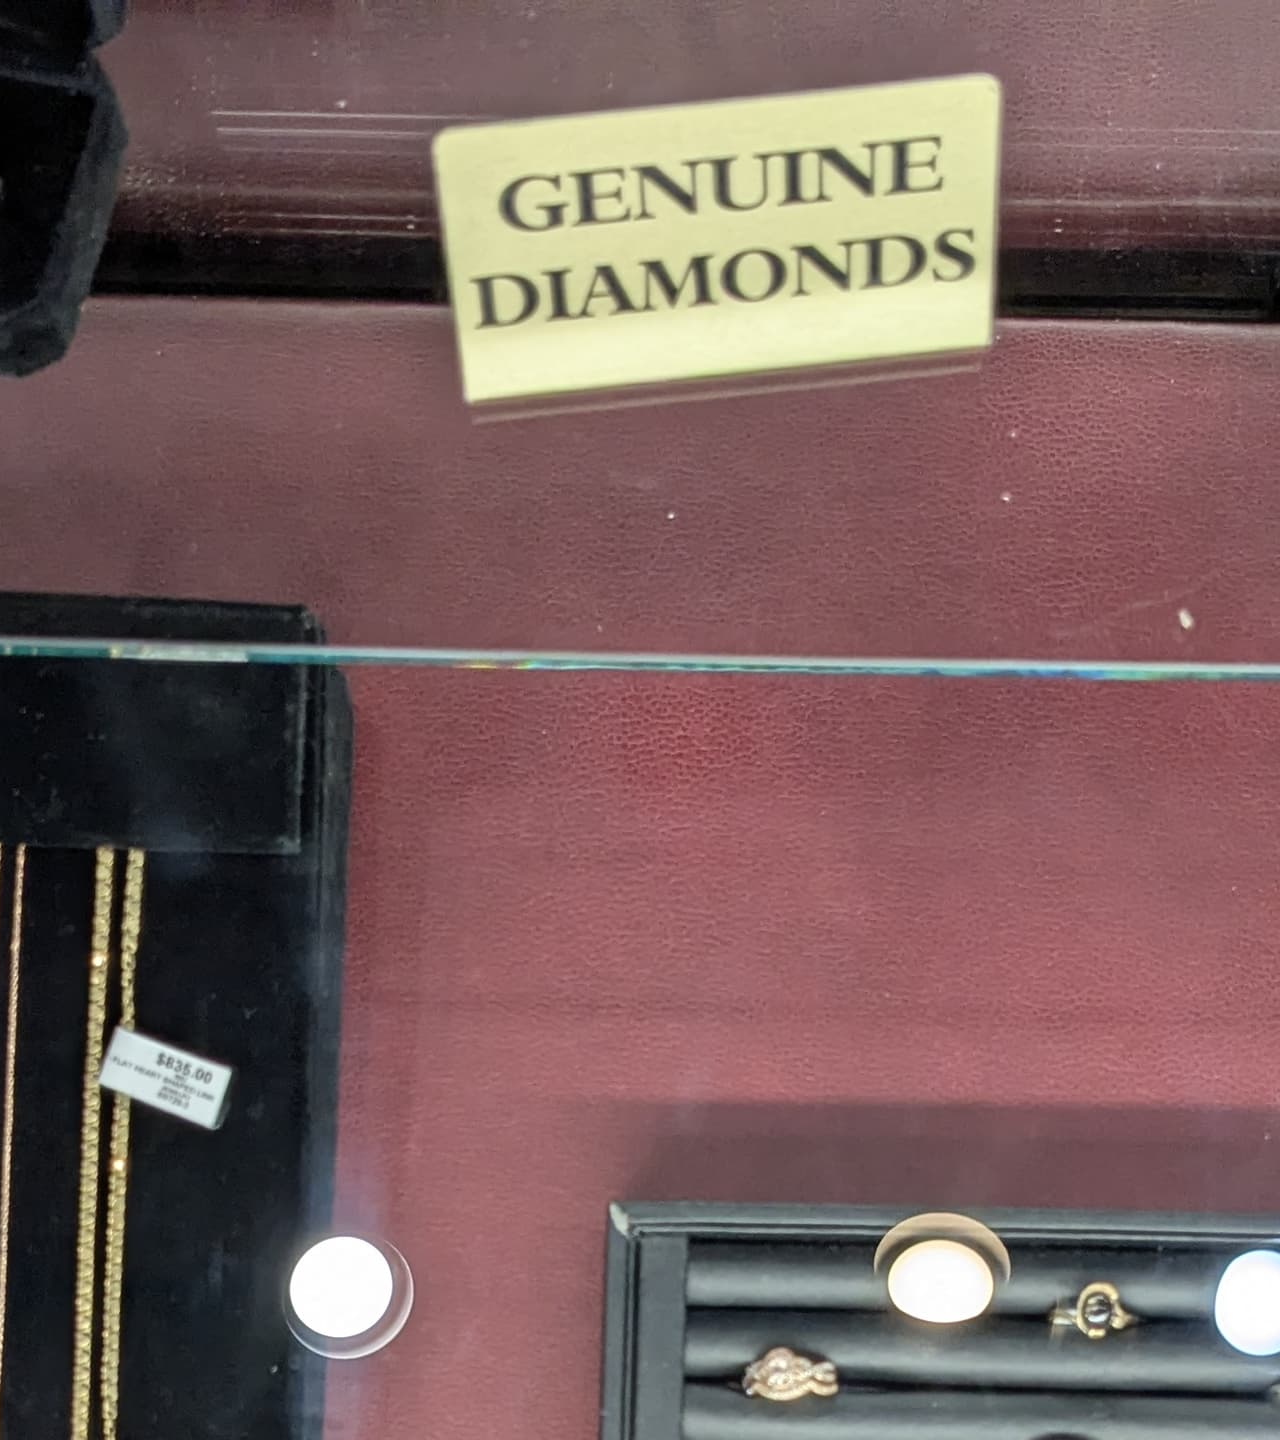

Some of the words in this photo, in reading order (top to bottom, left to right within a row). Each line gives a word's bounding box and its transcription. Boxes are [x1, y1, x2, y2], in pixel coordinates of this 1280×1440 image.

[497, 136, 944, 233] GENUINE
[470, 227, 977, 330] DIAMONDS
[155, 1052, 214, 1085] $835.00
